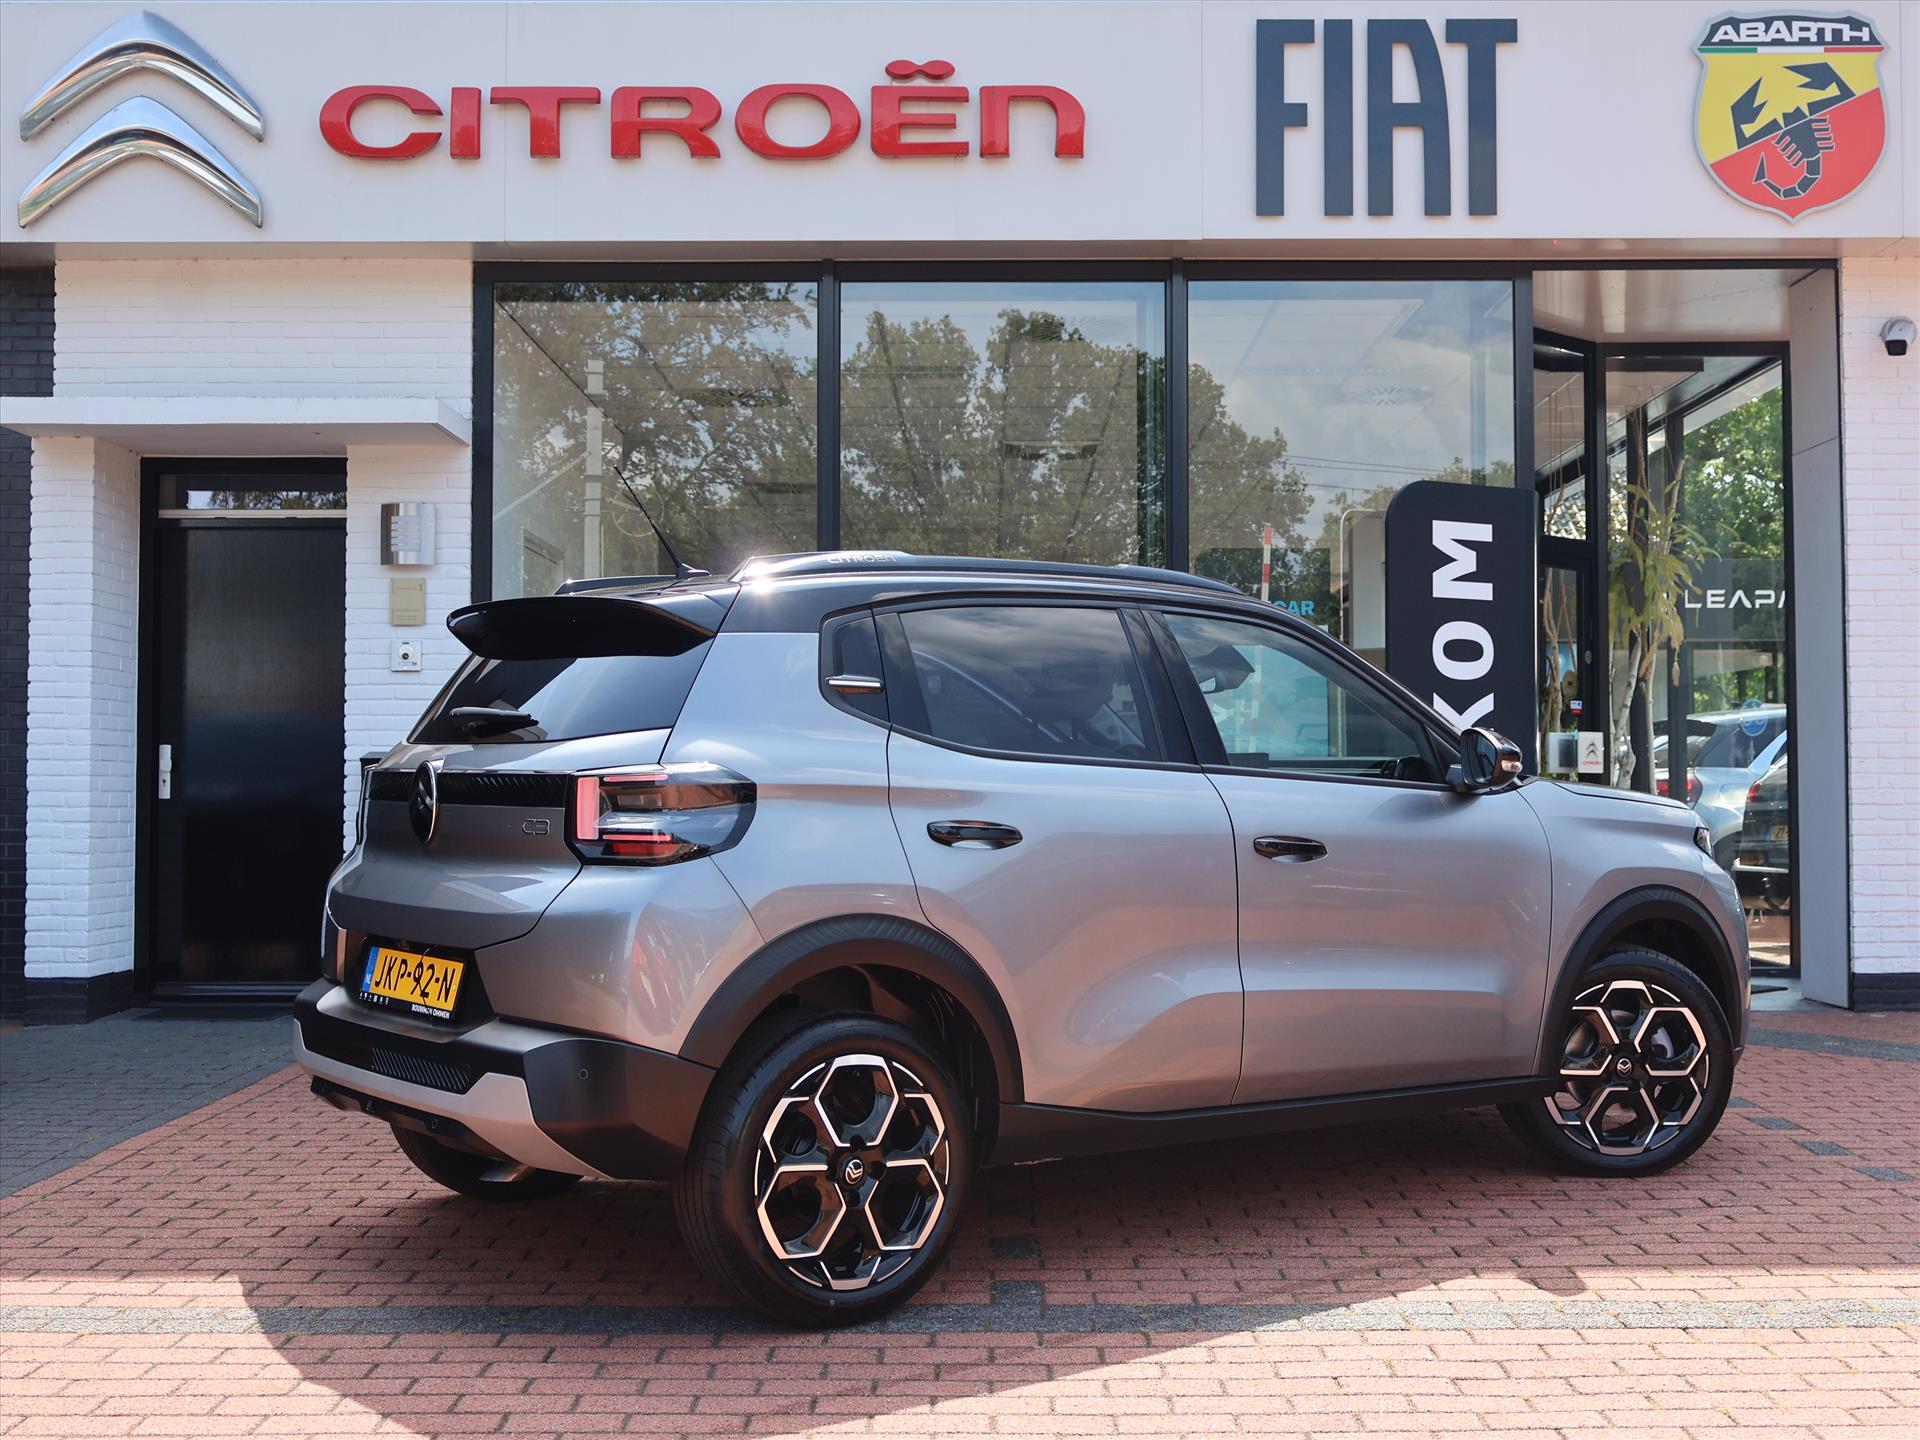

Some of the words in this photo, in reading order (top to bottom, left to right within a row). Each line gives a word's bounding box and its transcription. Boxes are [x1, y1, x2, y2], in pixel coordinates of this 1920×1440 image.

[1711, 21, 1870, 43] ABARTH
[319, 59, 1085, 160] CITROËN
[1256, 19, 1518, 216] FIAT
[522, 818, 551, 836] C3
[374, 954, 456, 1003] JKP-92-N
